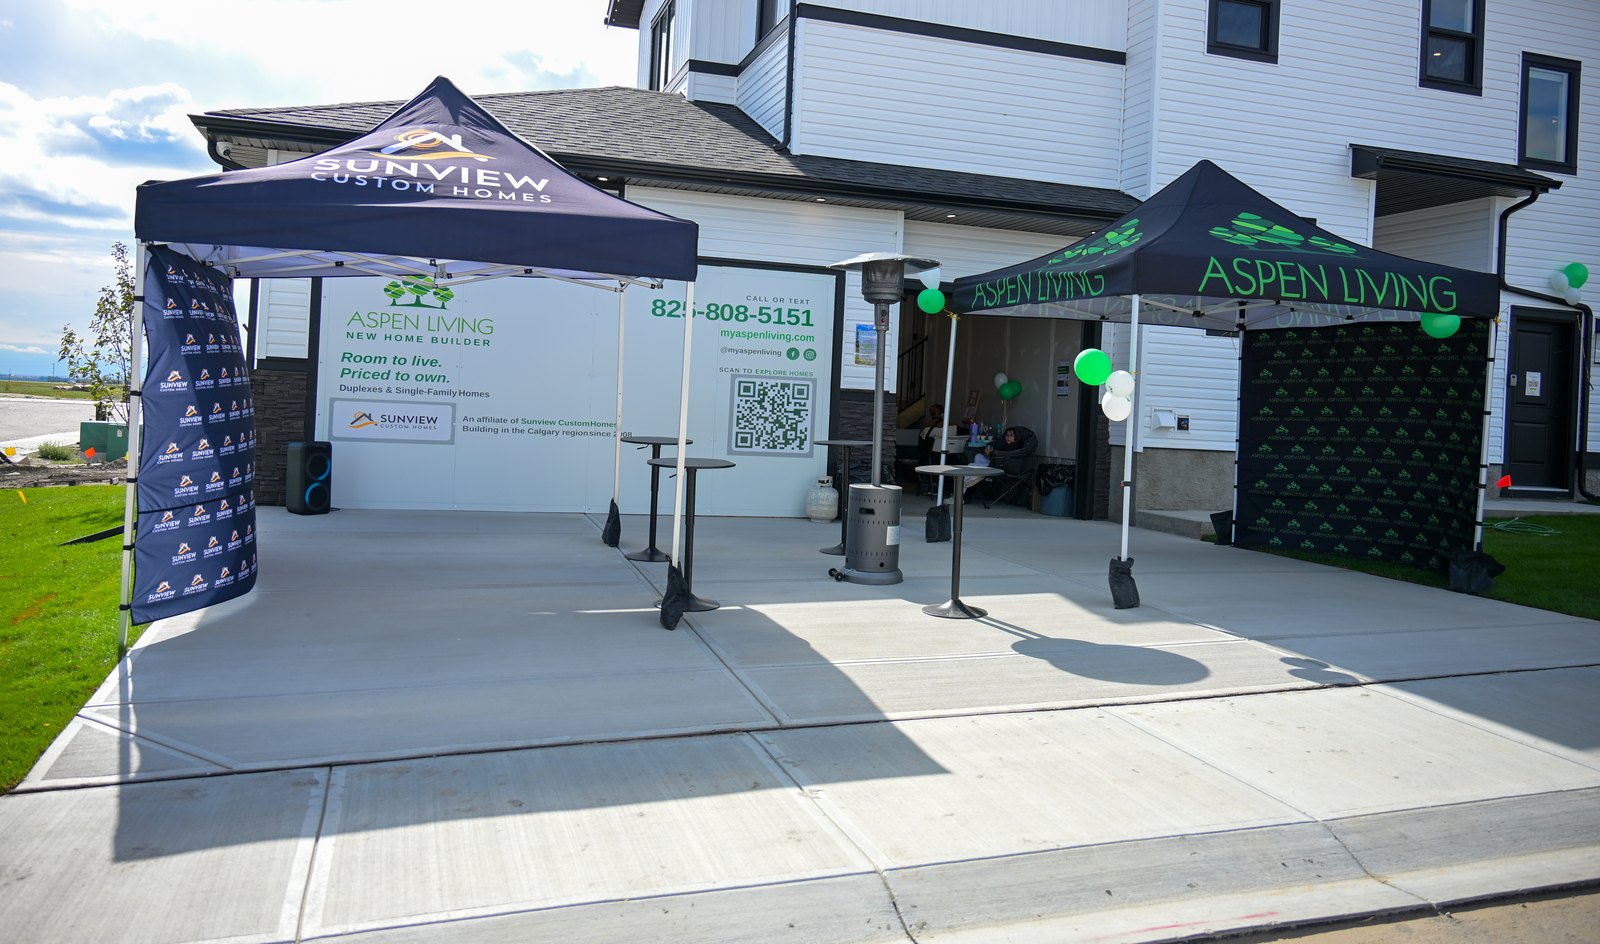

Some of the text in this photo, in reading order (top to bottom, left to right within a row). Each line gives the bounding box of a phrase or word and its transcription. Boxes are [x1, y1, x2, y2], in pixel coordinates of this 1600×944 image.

[313, 159, 549, 191] SUNVIEW
[310, 172, 552, 202] CUSTOM HOMES
[972, 270, 1104, 309] ASPEN LIVING
[1198, 256, 1456, 312] ASPEN LIVING
[746, 295, 769, 303] CALL
[346, 311, 494, 334] ASPEN LIVING
[346, 332, 490, 346] NEW HOME BUILDER
[720, 329, 814, 342] myaspenliving.com
[720, 346, 782, 357] @myaspenliving
[340, 352, 442, 368] Room to live.
[340, 368, 450, 384] Priced to own.
[340, 384, 382, 394] Duplexes
[395, 386, 457, 398] Single-Family
[458, 389, 490, 398] Homes
[380, 414, 438, 424] SUNVIEW
[476, 416, 508, 424] affiliate
[521, 418, 556, 426] Sunview
[462, 425, 498, 434] Building
[528, 428, 559, 436] Calgary
[158, 452, 183, 460] SUNVIEW
[174, 486, 199, 494] SUNVIEW
[172, 552, 196, 562] SUNVIEW
[148, 590, 176, 600] SUNVIEW
